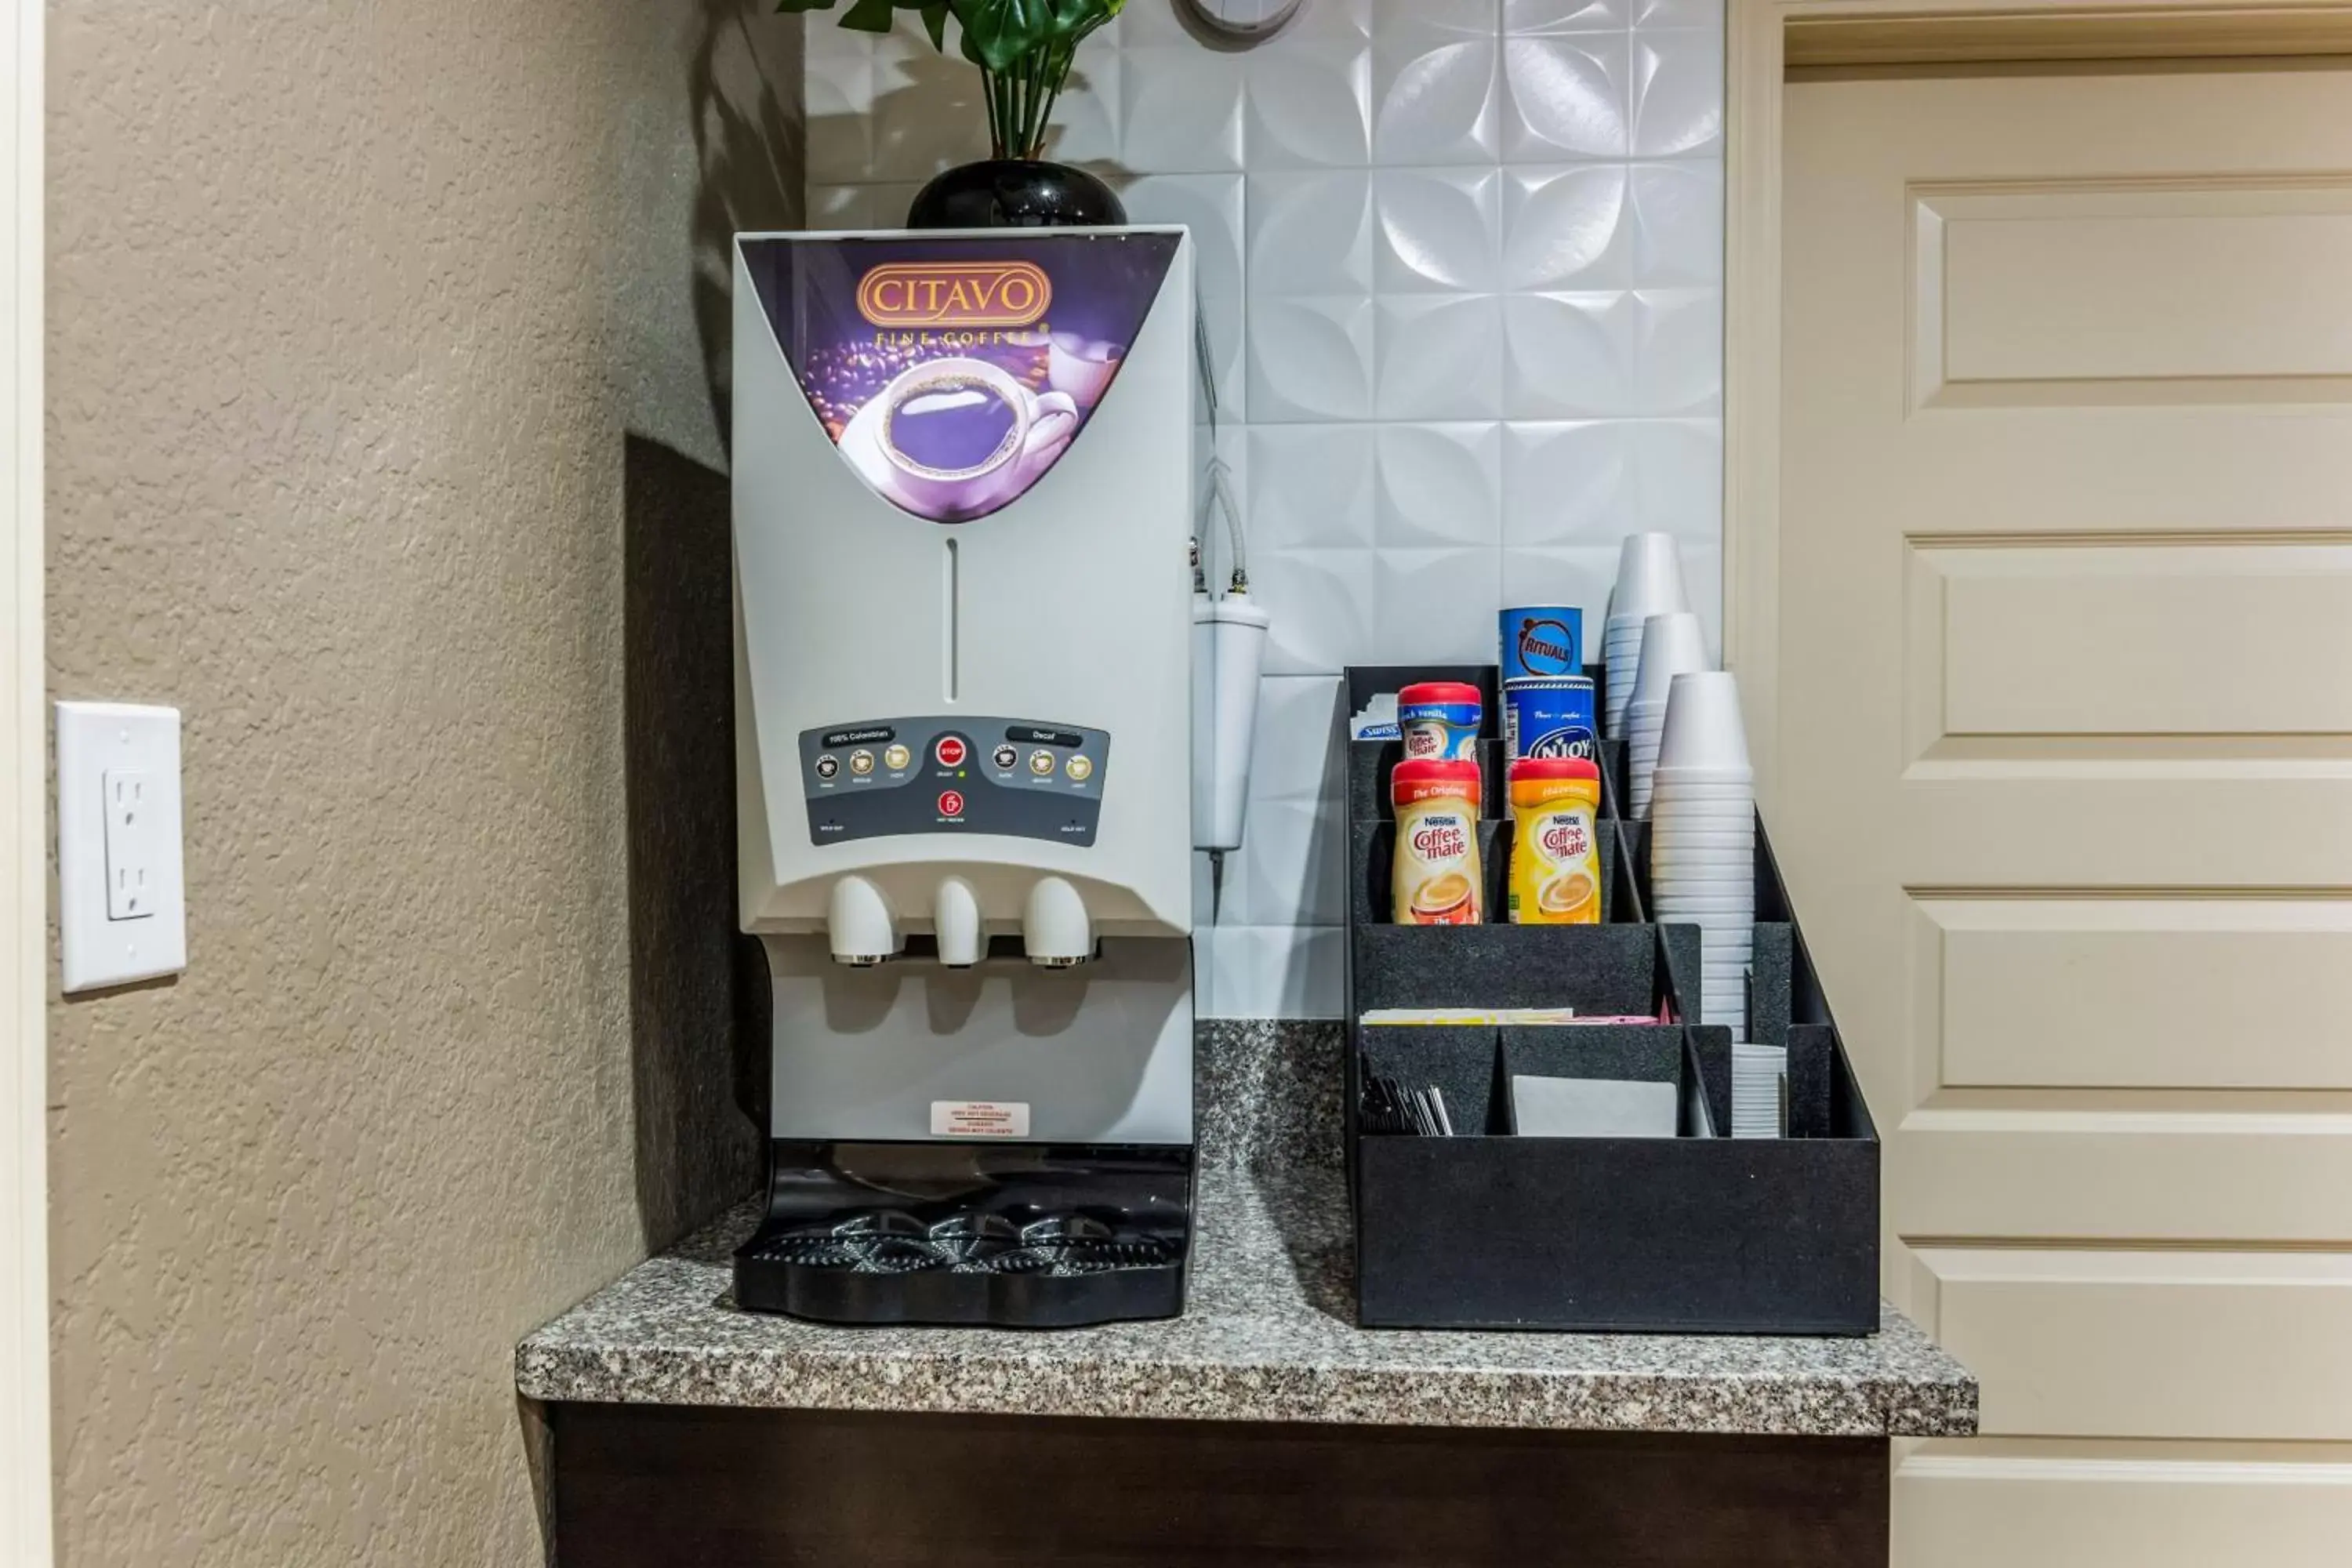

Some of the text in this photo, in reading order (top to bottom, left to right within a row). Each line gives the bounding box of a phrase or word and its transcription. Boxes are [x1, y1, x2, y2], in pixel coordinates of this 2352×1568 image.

[873, 278, 1035, 312] CITAVO
[876, 331, 1032, 347] FINE COFFEE
[1525, 637, 1569, 663] RITUALS
[1033, 730, 1056, 740] Decaf
[942, 747, 962, 756] STOP
[1428, 842, 1465, 860] mate
[1555, 841, 1588, 858] mate
